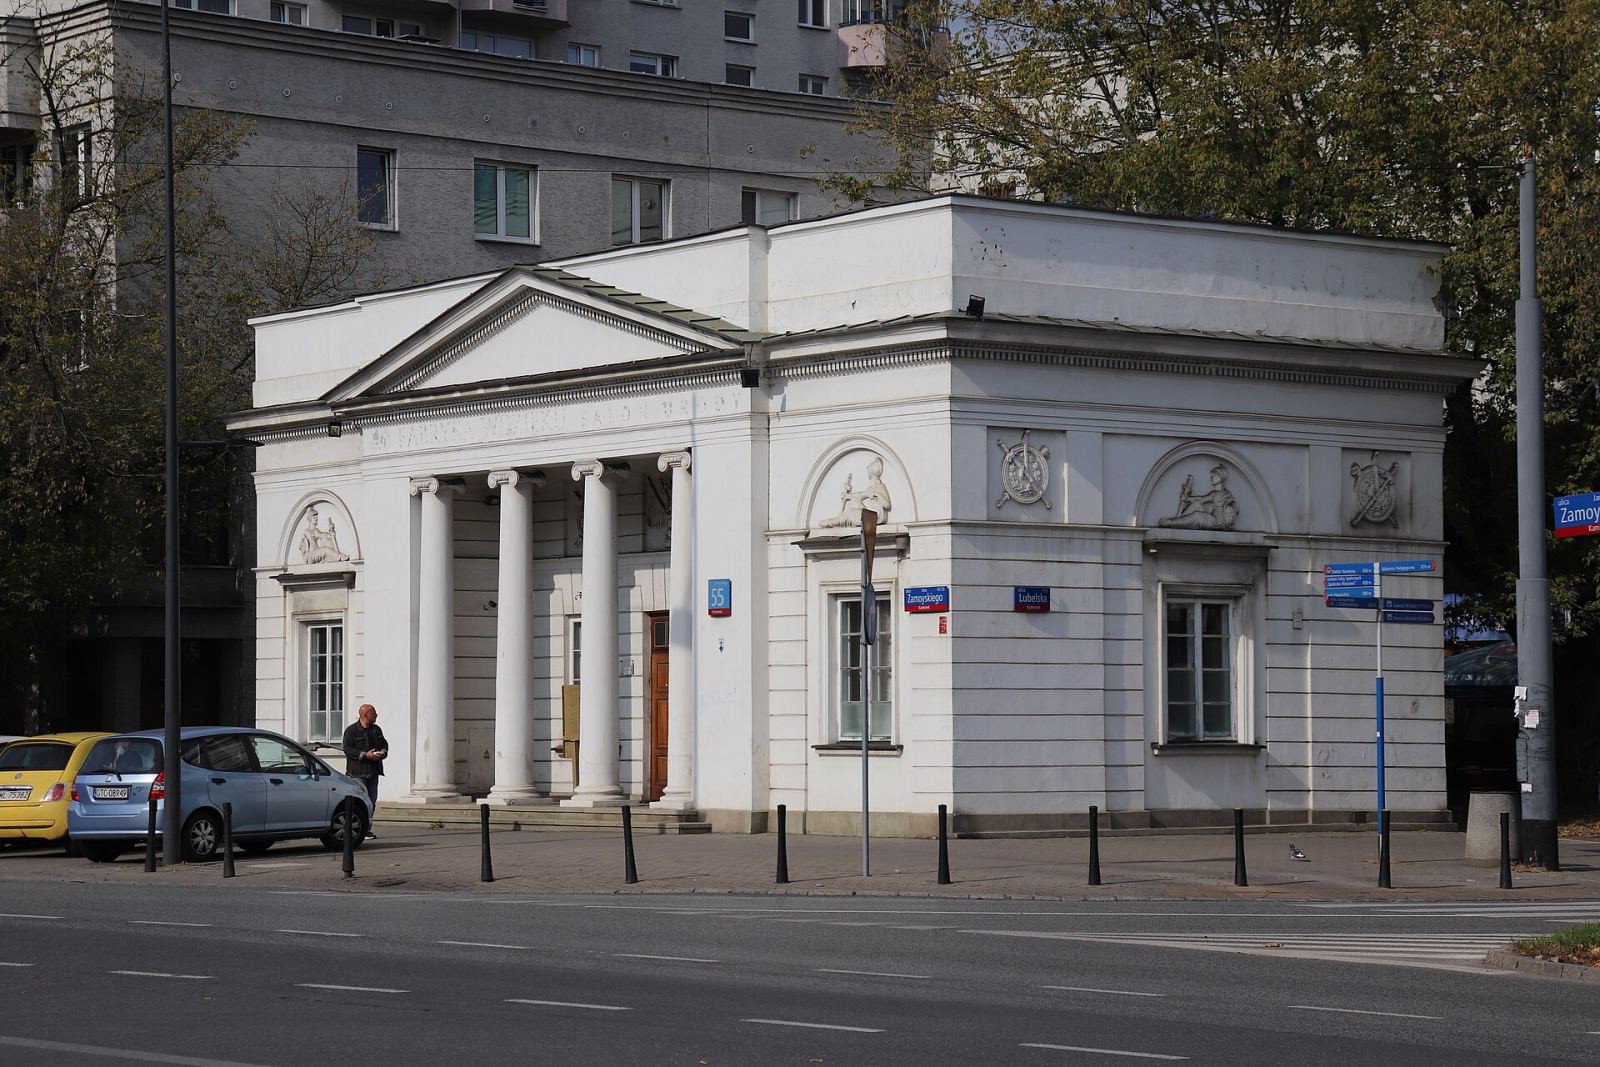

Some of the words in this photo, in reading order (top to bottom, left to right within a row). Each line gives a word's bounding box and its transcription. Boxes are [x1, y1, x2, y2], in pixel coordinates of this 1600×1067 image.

[1560, 507, 1600, 523] Zamoy
[711, 588, 724, 607] 55
[907, 592, 943, 605] Zamoyskiego
[1019, 593, 1048, 602] Lubelska
